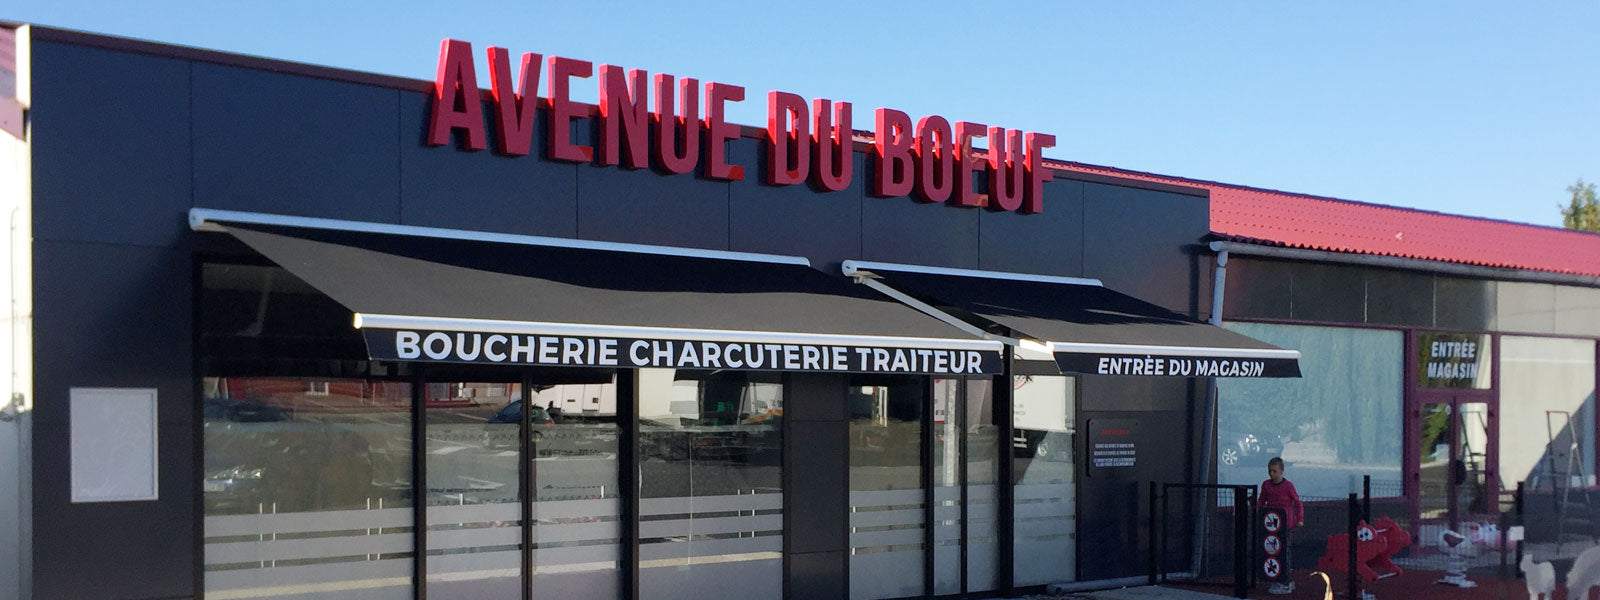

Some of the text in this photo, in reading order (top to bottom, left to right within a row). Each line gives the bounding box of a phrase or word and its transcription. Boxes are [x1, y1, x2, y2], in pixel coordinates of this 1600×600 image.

[427, 38, 1056, 212] AVENUE DU BOEUF
[396, 330, 983, 374] BOUCHERIE CHARCUTERIE TRAITEUR
[1431, 339, 1477, 358] ENTRÉE
[1097, 354, 1265, 377] ENTRÉE DU MAGASIN
[1427, 362, 1480, 378] MAGASIN
